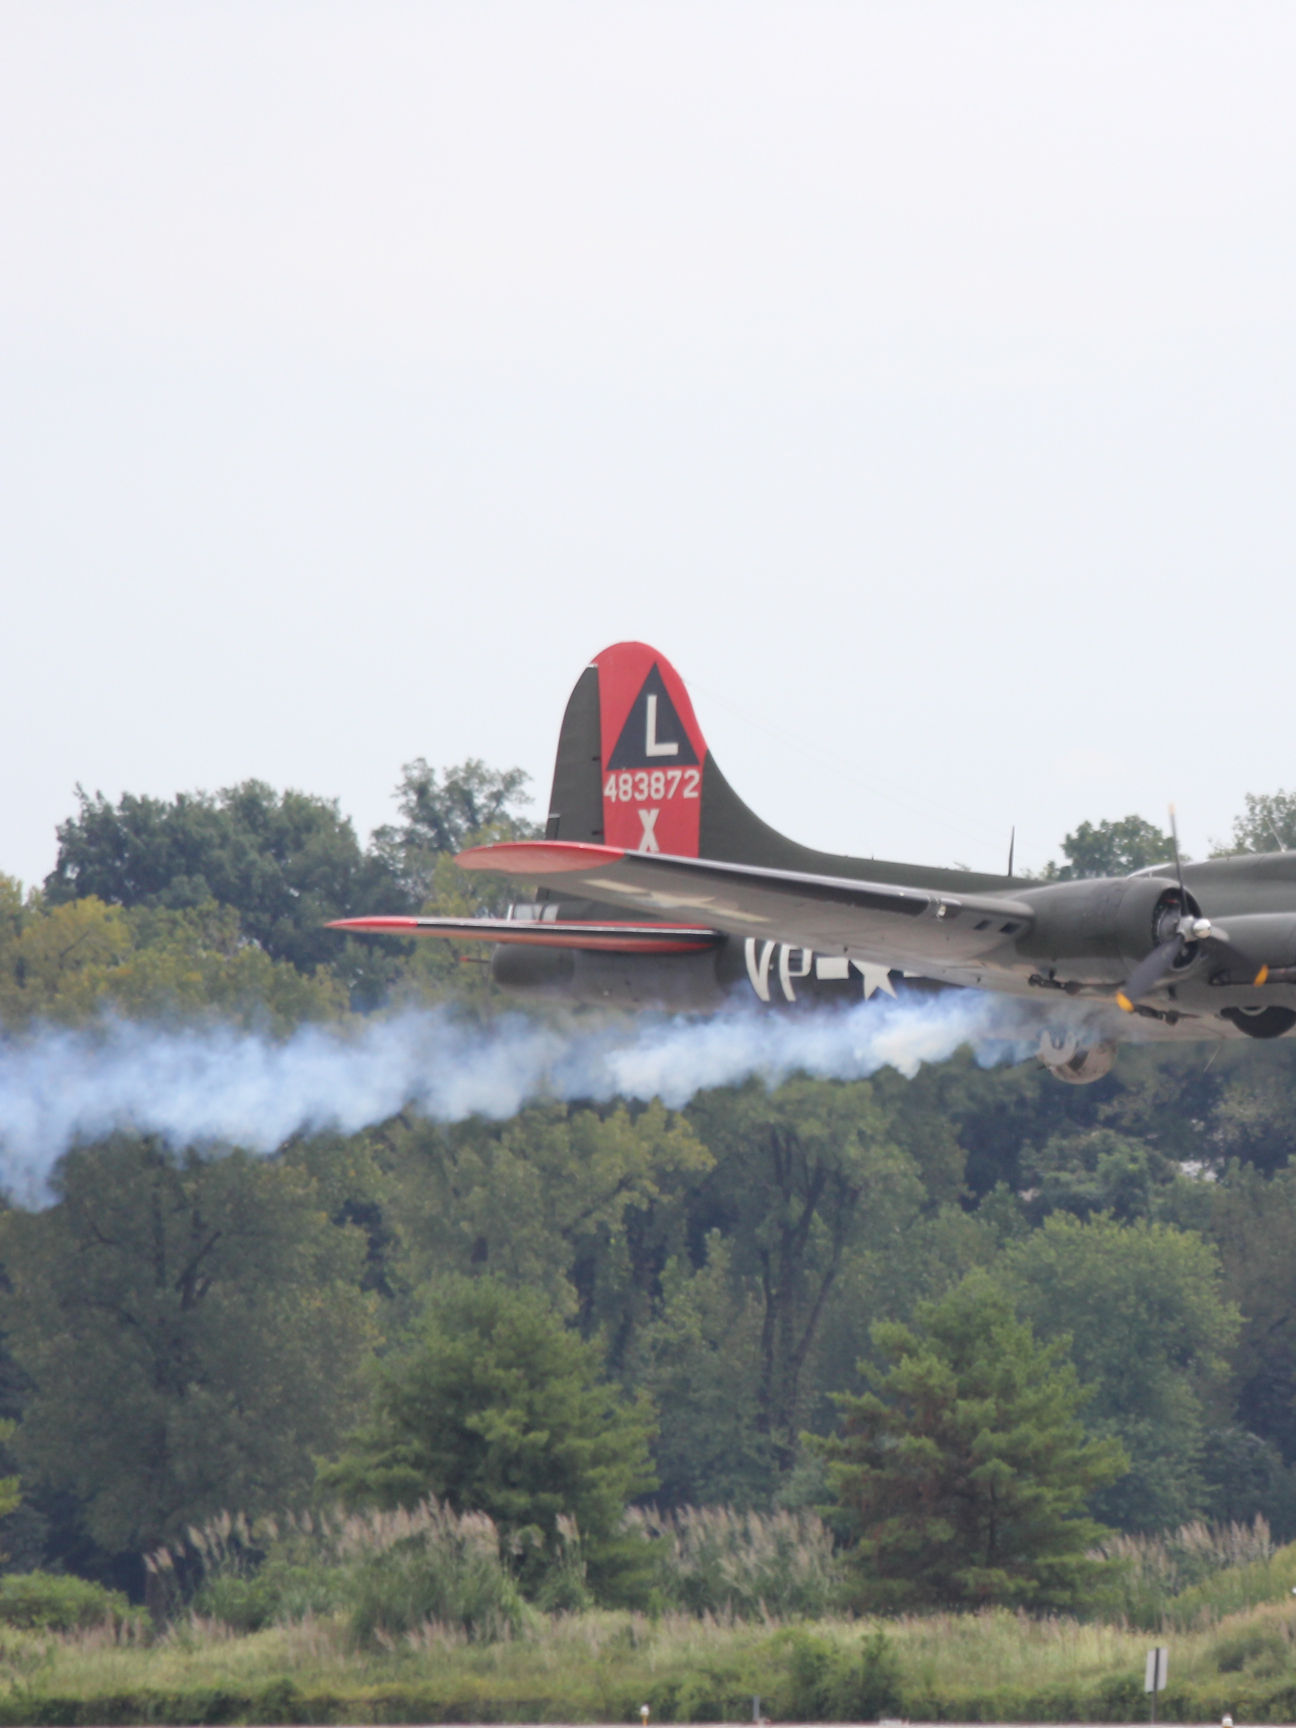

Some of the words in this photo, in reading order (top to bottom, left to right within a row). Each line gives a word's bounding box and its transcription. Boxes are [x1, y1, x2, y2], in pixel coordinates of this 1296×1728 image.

[646, 694, 678, 757] L
[604, 770, 699, 802] 483872
[637, 809, 660, 853] X
[744, 937, 812, 1002] VP
